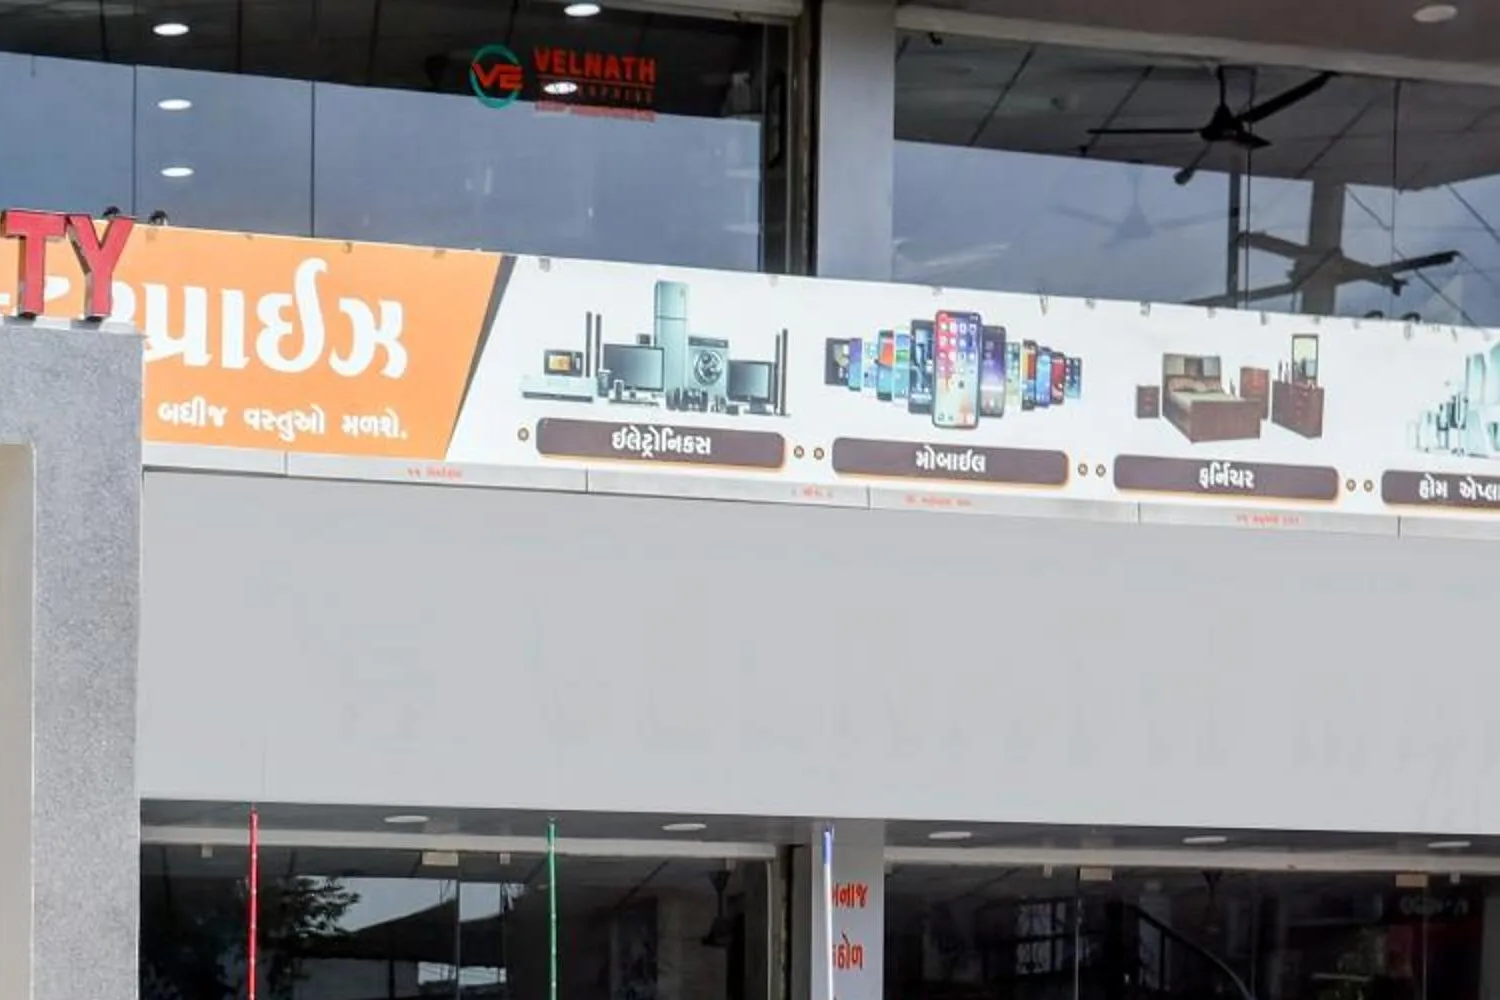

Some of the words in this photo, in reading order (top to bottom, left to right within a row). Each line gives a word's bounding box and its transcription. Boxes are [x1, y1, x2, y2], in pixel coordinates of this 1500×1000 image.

[534, 46, 656, 83] VELNATH
[915, 445, 986, 473] મોબાઈલ
[1419, 473, 1448, 499] હોમ
